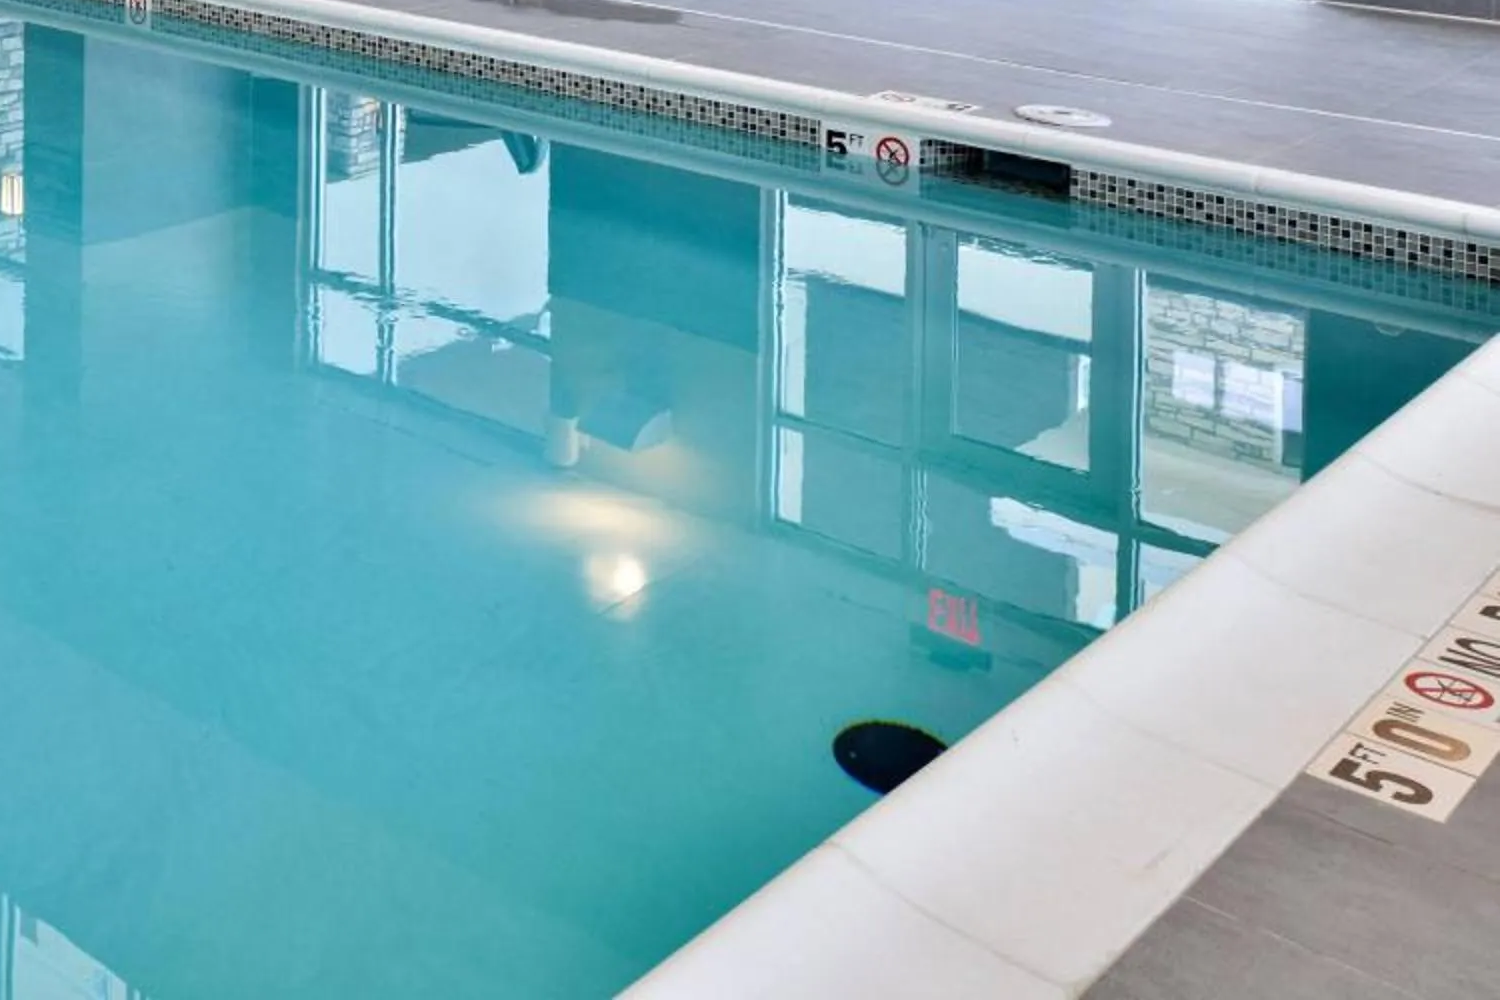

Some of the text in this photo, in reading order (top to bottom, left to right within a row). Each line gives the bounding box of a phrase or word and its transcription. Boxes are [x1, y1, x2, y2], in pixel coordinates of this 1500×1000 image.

[826, 130, 864, 155] 5 FT
[1348, 742, 1387, 765] FT
[1328, 758, 1434, 805] 5
